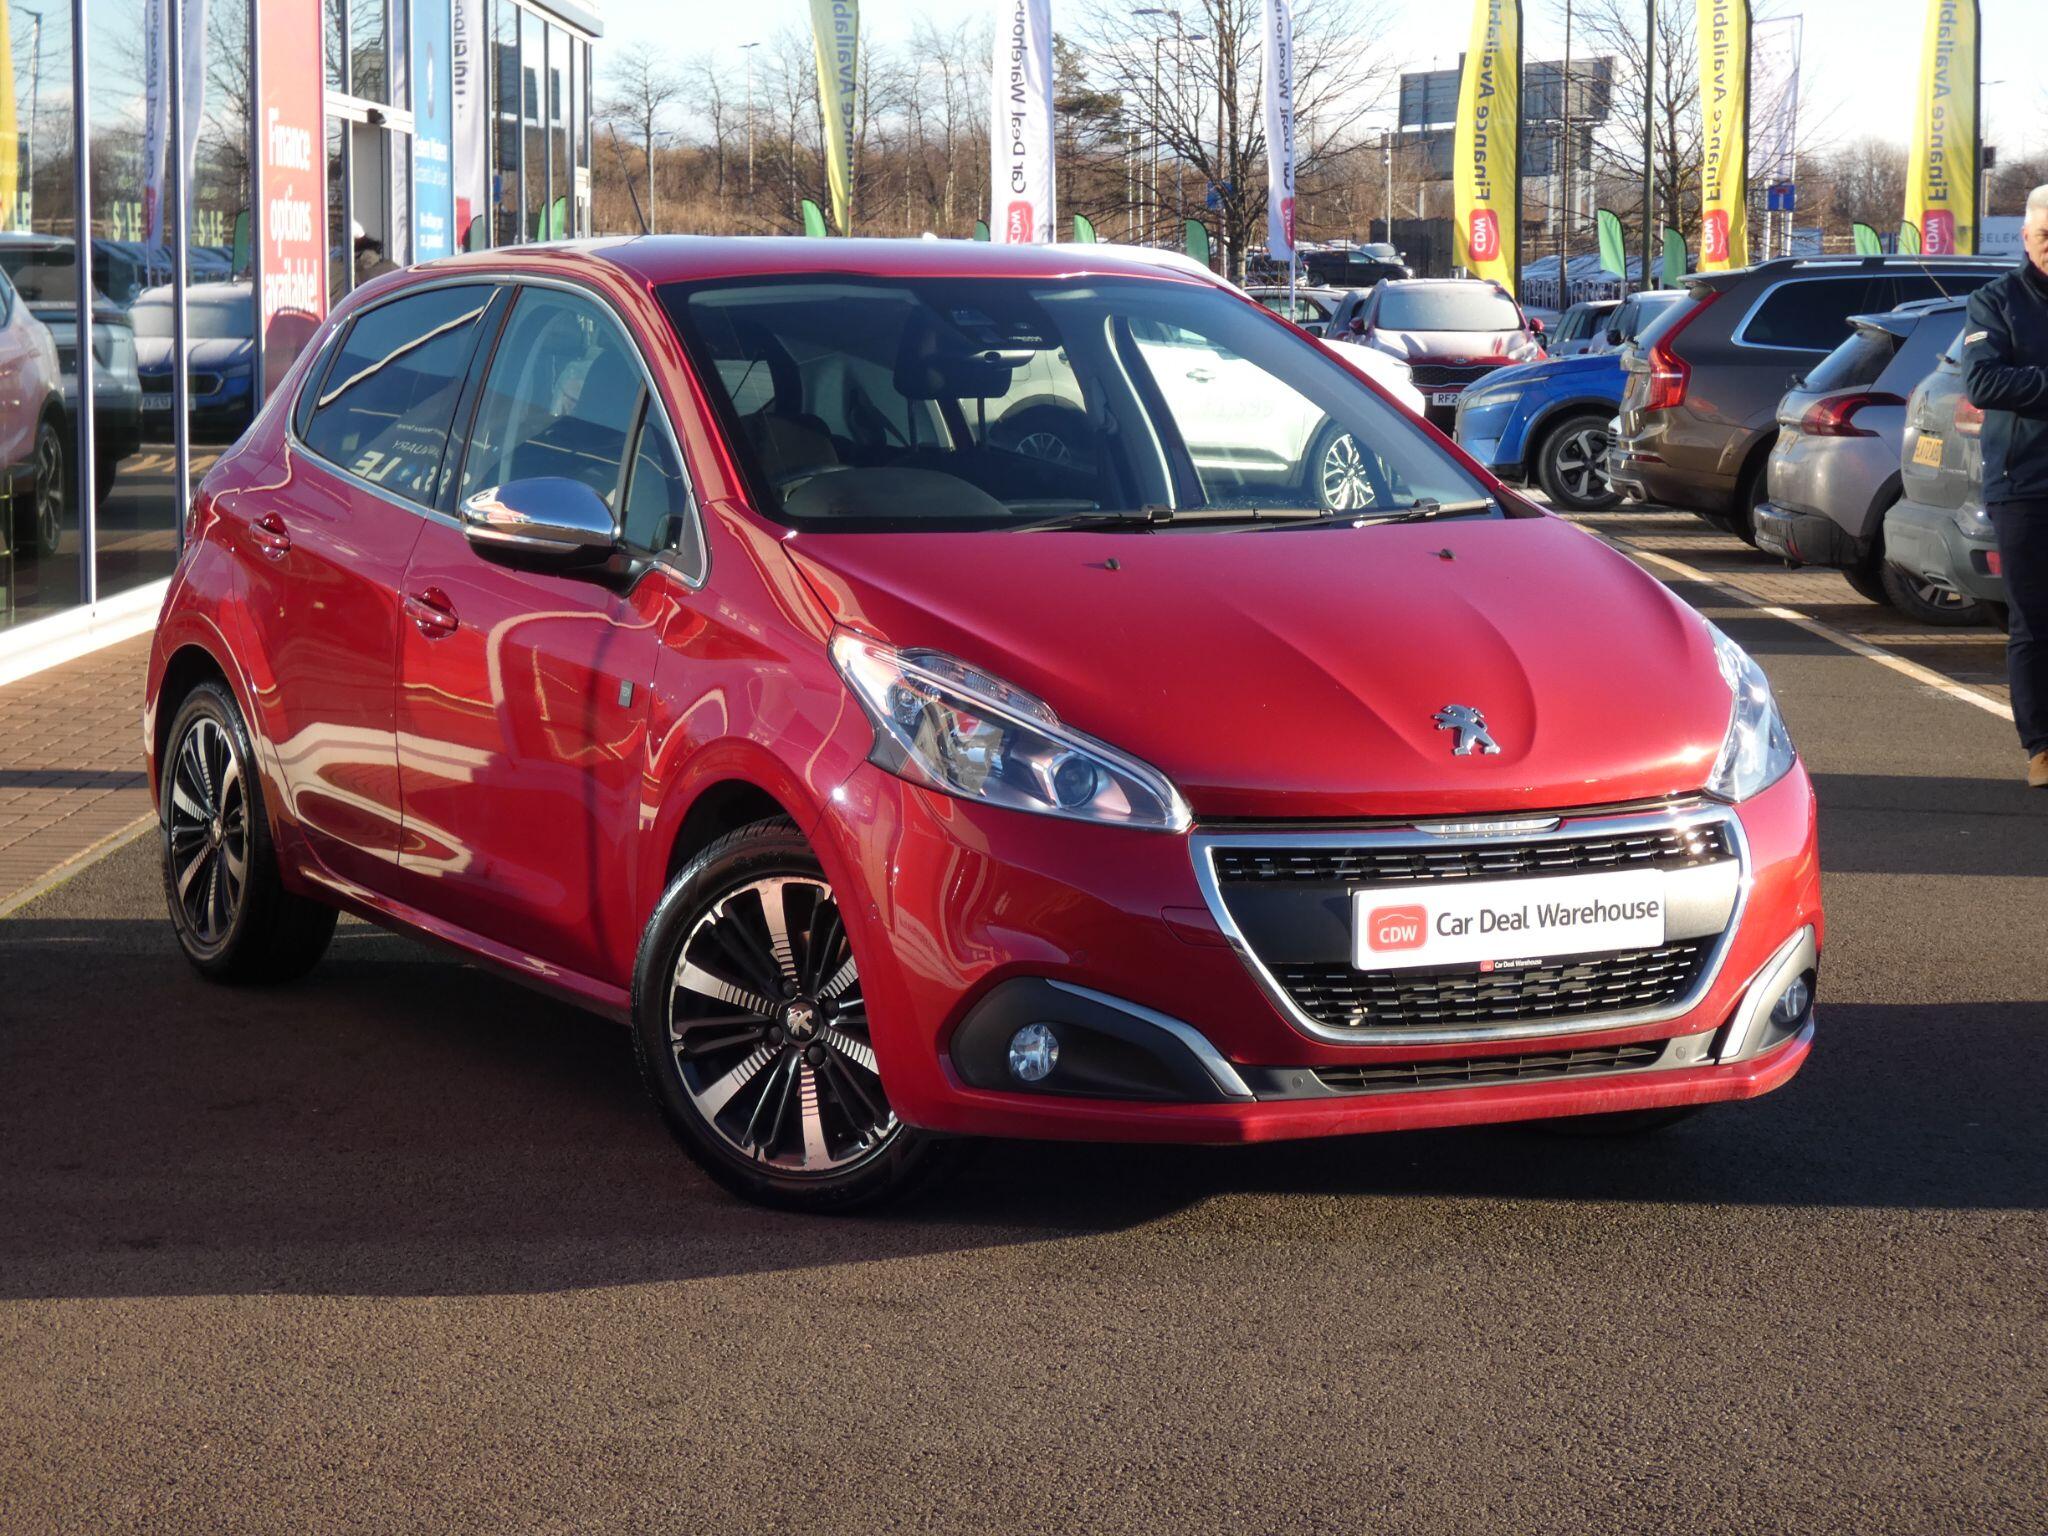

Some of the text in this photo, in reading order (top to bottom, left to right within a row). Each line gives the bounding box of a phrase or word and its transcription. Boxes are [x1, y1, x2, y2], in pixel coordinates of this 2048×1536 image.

[267, 107, 312, 172] Finance
[269, 184, 313, 258] options
[1379, 899, 1660, 944] CDW Car Deal Warehouse
[1494, 961, 1503, 969] Car
